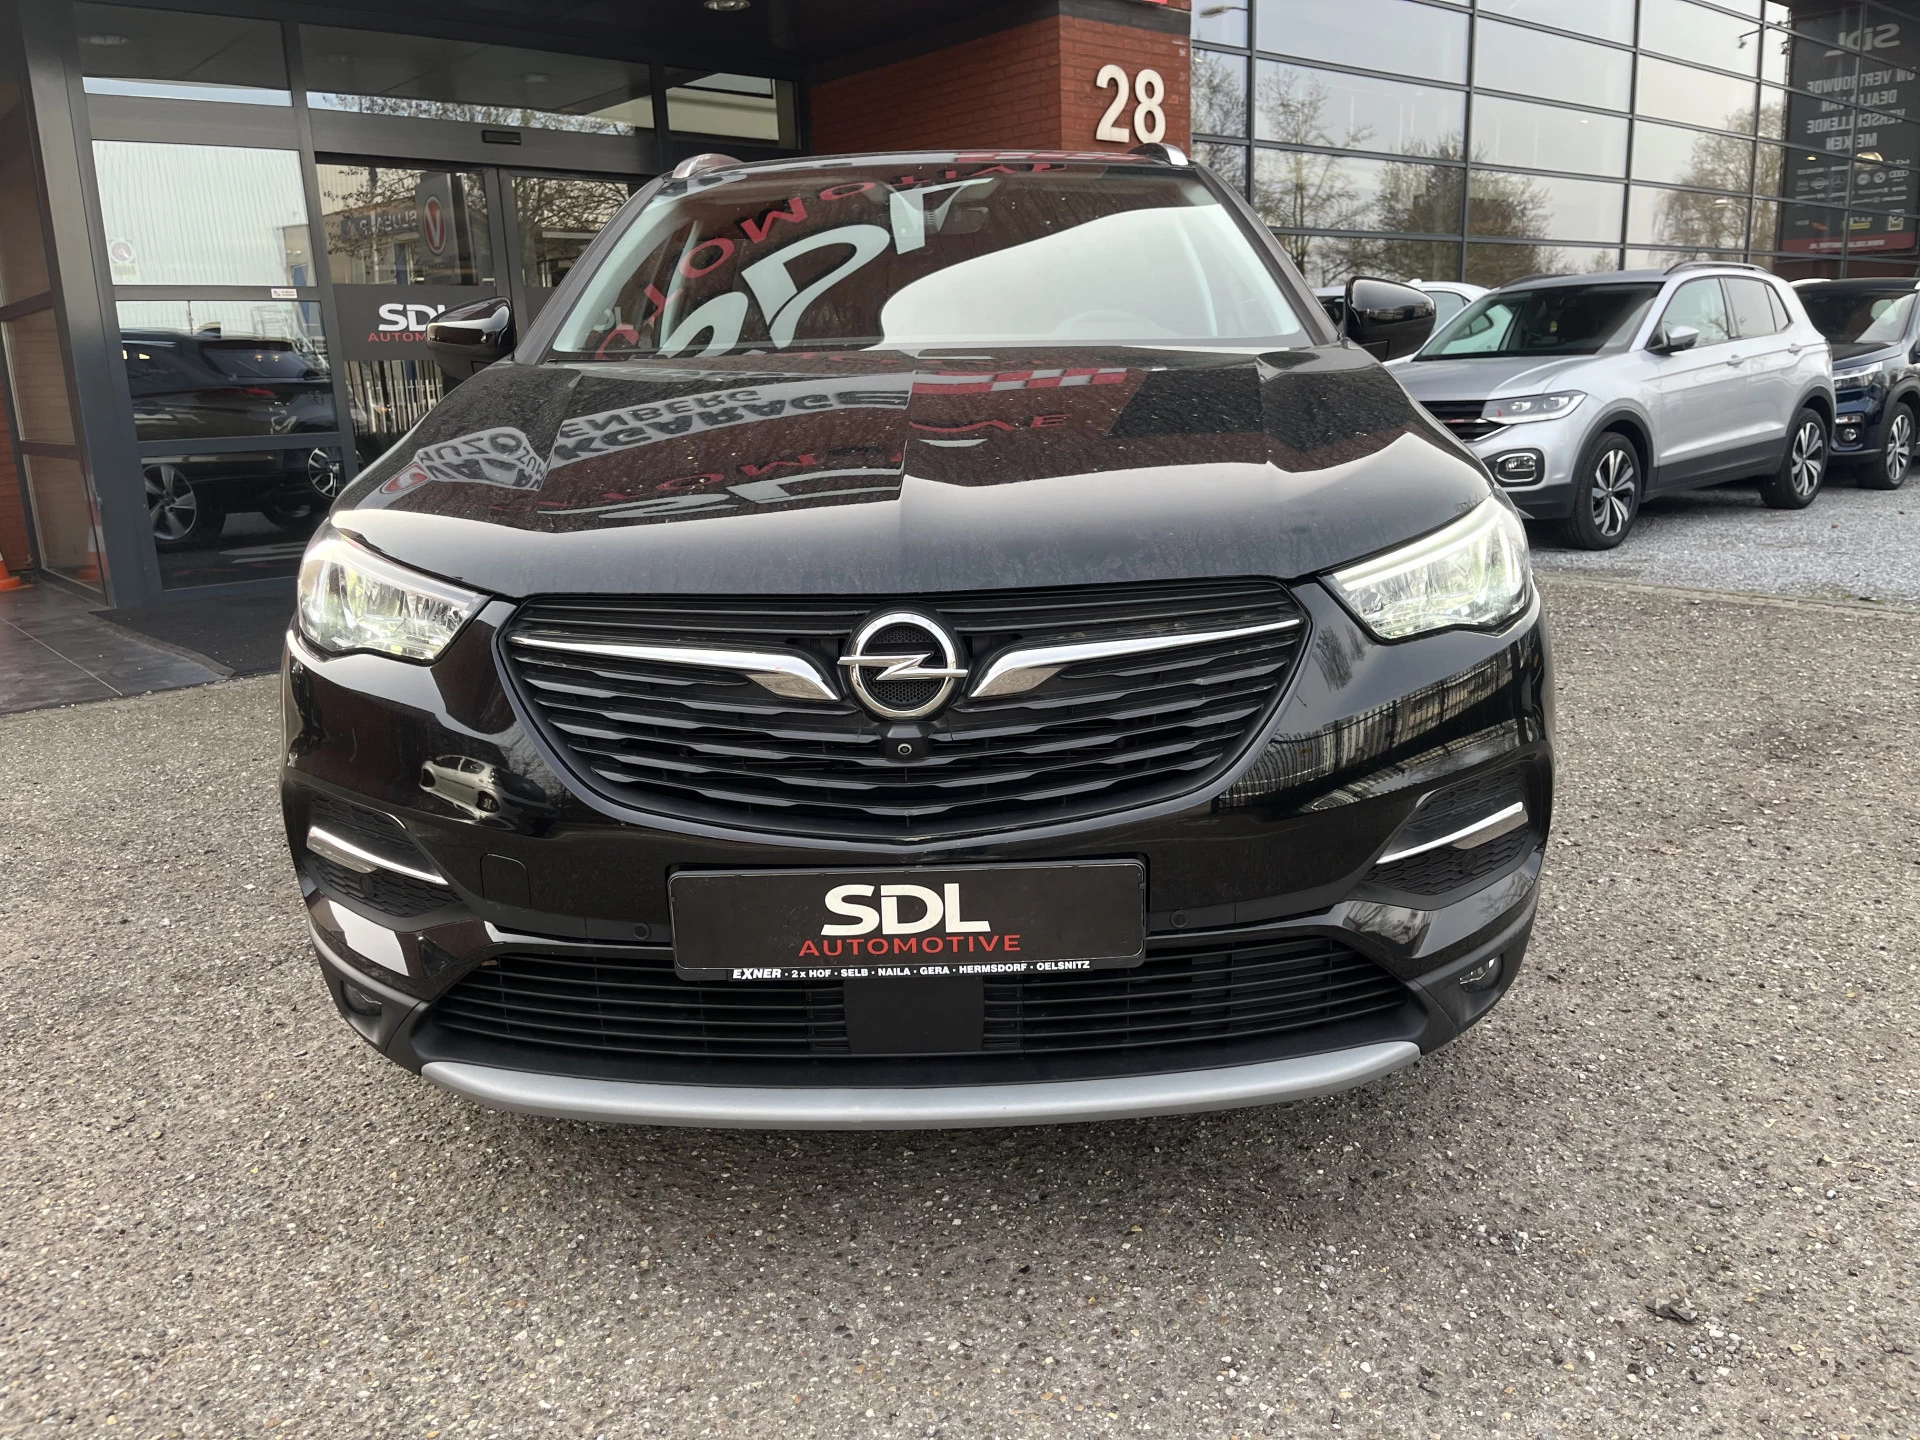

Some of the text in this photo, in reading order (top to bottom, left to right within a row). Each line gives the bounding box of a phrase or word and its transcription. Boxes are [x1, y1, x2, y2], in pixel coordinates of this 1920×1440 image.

[1096, 64, 1167, 144] 28
[821, 883, 991, 936] SDL
[799, 934, 1021, 957] AUTOMOTIVE
[732, 968, 782, 980] EXNER
[808, 969, 832, 978] HOF
[840, 968, 869, 977] SELB
[877, 966, 911, 976] NAILA
[919, 965, 950, 975] GERA
[958, 962, 1027, 974] HERMSDORF
[1036, 960, 1090, 971] OELSNITZ
